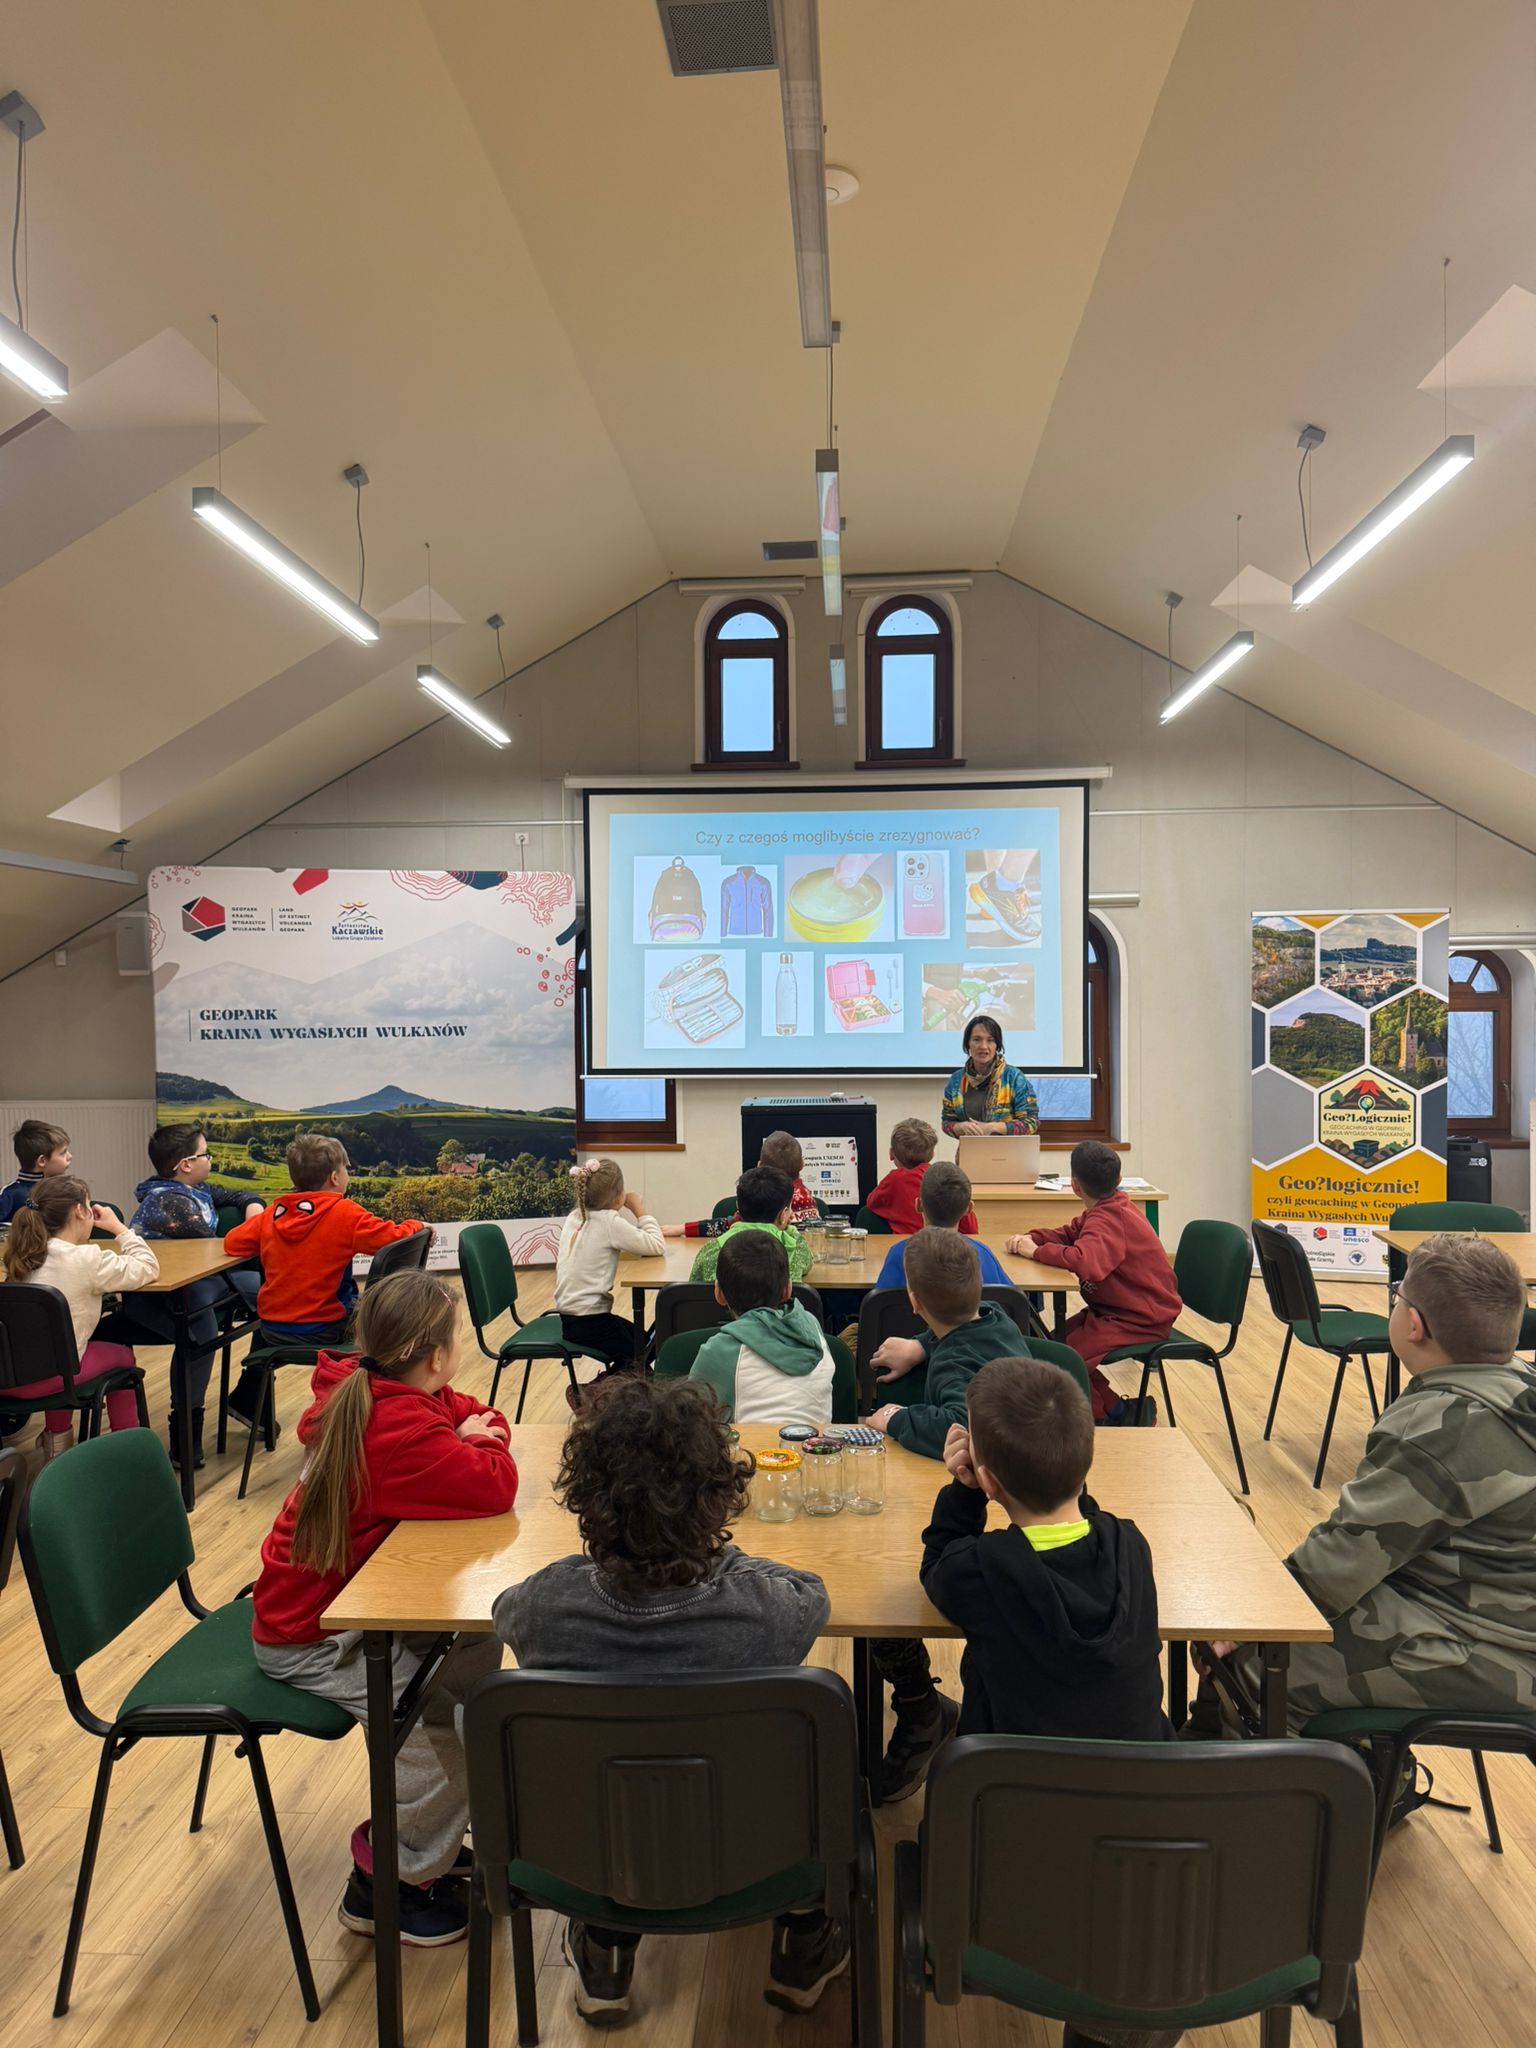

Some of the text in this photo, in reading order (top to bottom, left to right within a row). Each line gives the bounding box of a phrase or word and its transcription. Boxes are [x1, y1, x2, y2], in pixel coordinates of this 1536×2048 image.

[695, 827, 980, 847] Czy z czegoś moglibyście zrezygnować?
[331, 926, 384, 935] Kaczawskie
[199, 1008, 278, 1021] GEOPARK
[200, 1022, 468, 1041] KRAINA WYGASŁYCH WULKANÓW
[1323, 1112, 1412, 1124] Geo?Logicznie!
[1279, 1175, 1419, 1195] Geo?logicznie!
[1267, 1196, 1292, 1206] czyli
[1294, 1197, 1358, 1209] geocaching
[1267, 1208, 1305, 1219] Kraina
[1308, 1209, 1367, 1223] Wygasłych
